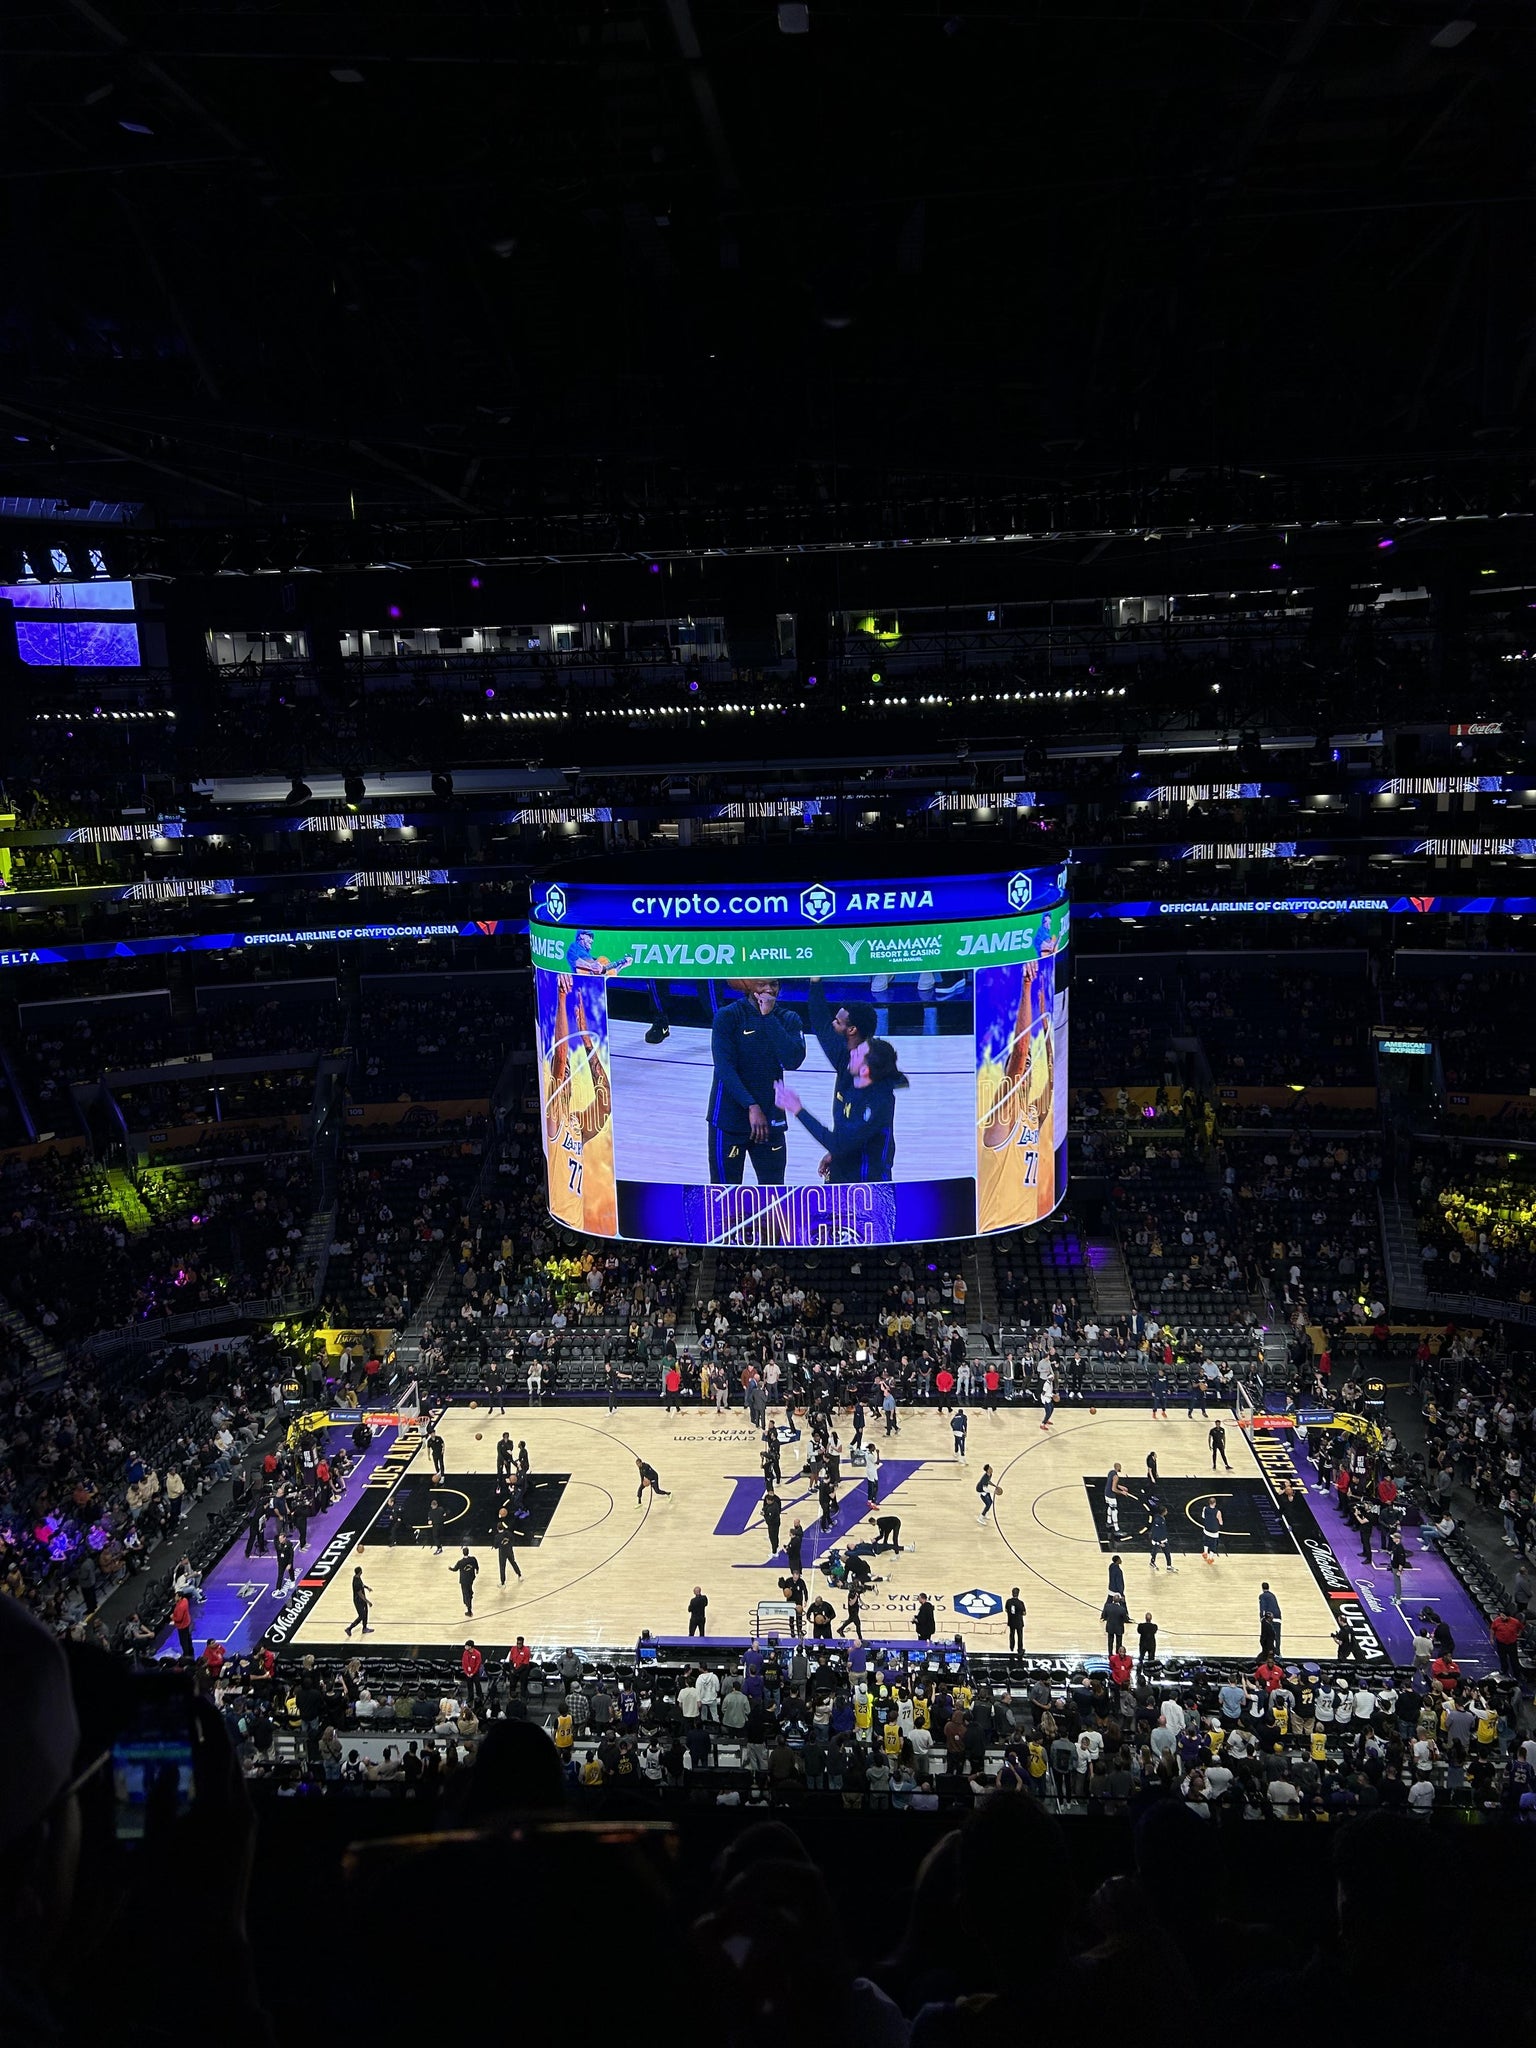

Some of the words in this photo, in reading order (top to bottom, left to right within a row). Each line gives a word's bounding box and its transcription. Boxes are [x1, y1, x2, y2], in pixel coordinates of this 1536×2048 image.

[632, 894, 788, 918] crypto.com
[846, 890, 934, 911] ARENA
[1160, 903, 1209, 913] OFFICIAL
[1211, 902, 1254, 911] AIRLINE
[1255, 901, 1271, 910] OF
[1272, 901, 1347, 910] CRYPTO.COM
[1349, 900, 1388, 909] ARENA
[244, 934, 294, 944] OFFICIAL
[296, 931, 336, 941] AIRLINE
[338, 929, 352, 938] OF
[354, 926, 422, 938] CRYPTO.COM
[424, 925, 459, 935] ARENA
[956, 928, 1034, 956] JAMES
[631, 944, 735, 965] TAYLOR
[749, 948, 792, 960] APRIL
[796, 947, 813, 959] 26
[870, 950, 901, 959] RESORT
[910, 949, 941, 957] CASINO
[1389, 1047, 1426, 1055] EXPRESS
[362, 1465, 404, 1489] LOS
[310, 1530, 356, 1577] ULTRA
[1304, 1538, 1349, 1589] Michelob
[264, 1589, 314, 1643] Michelob
[1024, 1658, 1078, 1673] AT&T
[625, 1702, 634, 1712] 77
[858, 1705, 868, 1714] 23
